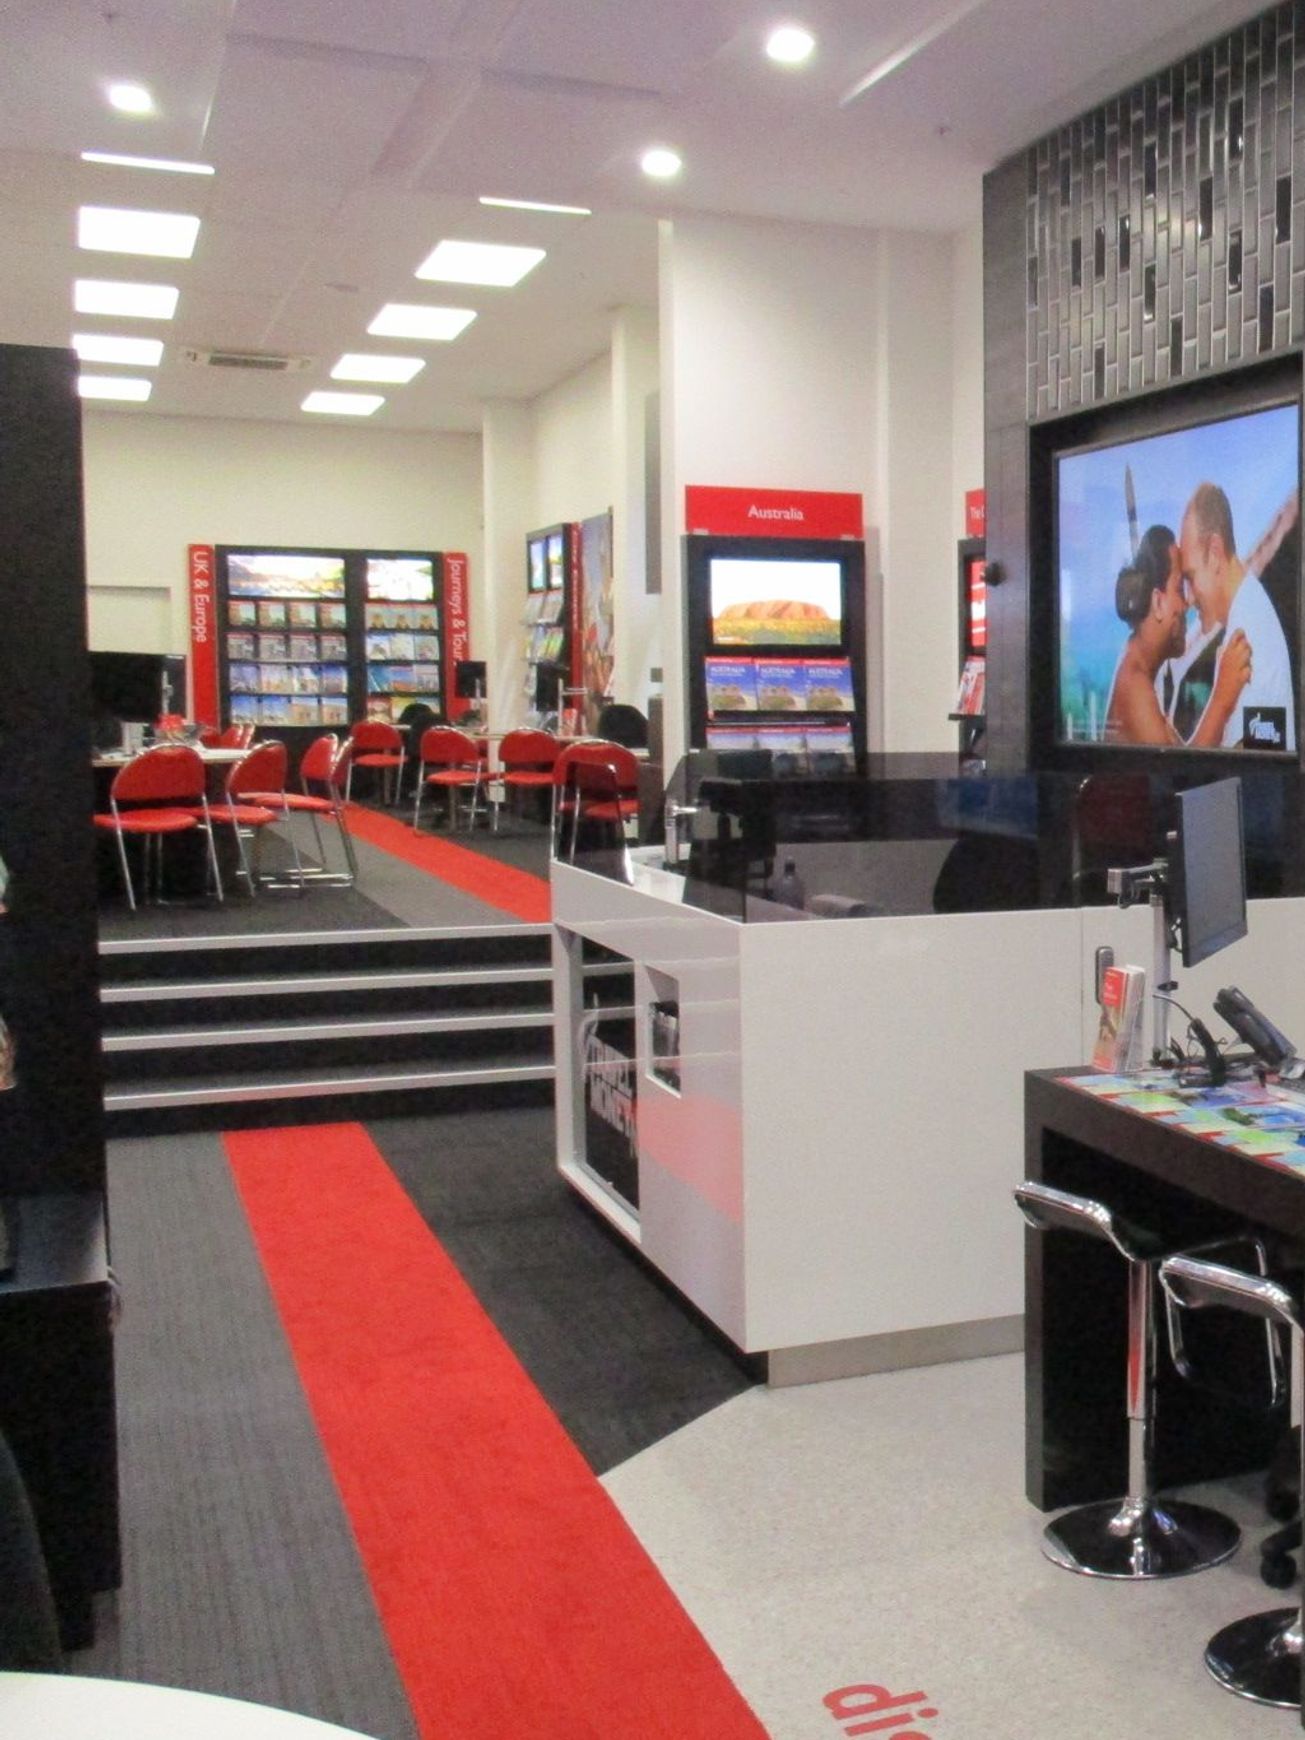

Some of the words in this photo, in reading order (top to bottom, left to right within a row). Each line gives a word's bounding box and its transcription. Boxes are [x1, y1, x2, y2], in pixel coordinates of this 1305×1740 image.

[748, 504, 804, 522] Australia
[194, 551, 209, 576] UK
[195, 579, 209, 593] &
[446, 559, 465, 615] Journeys
[192, 595, 210, 644] Europe
[452, 618, 466, 631] &
[454, 632, 468, 667] Tour
